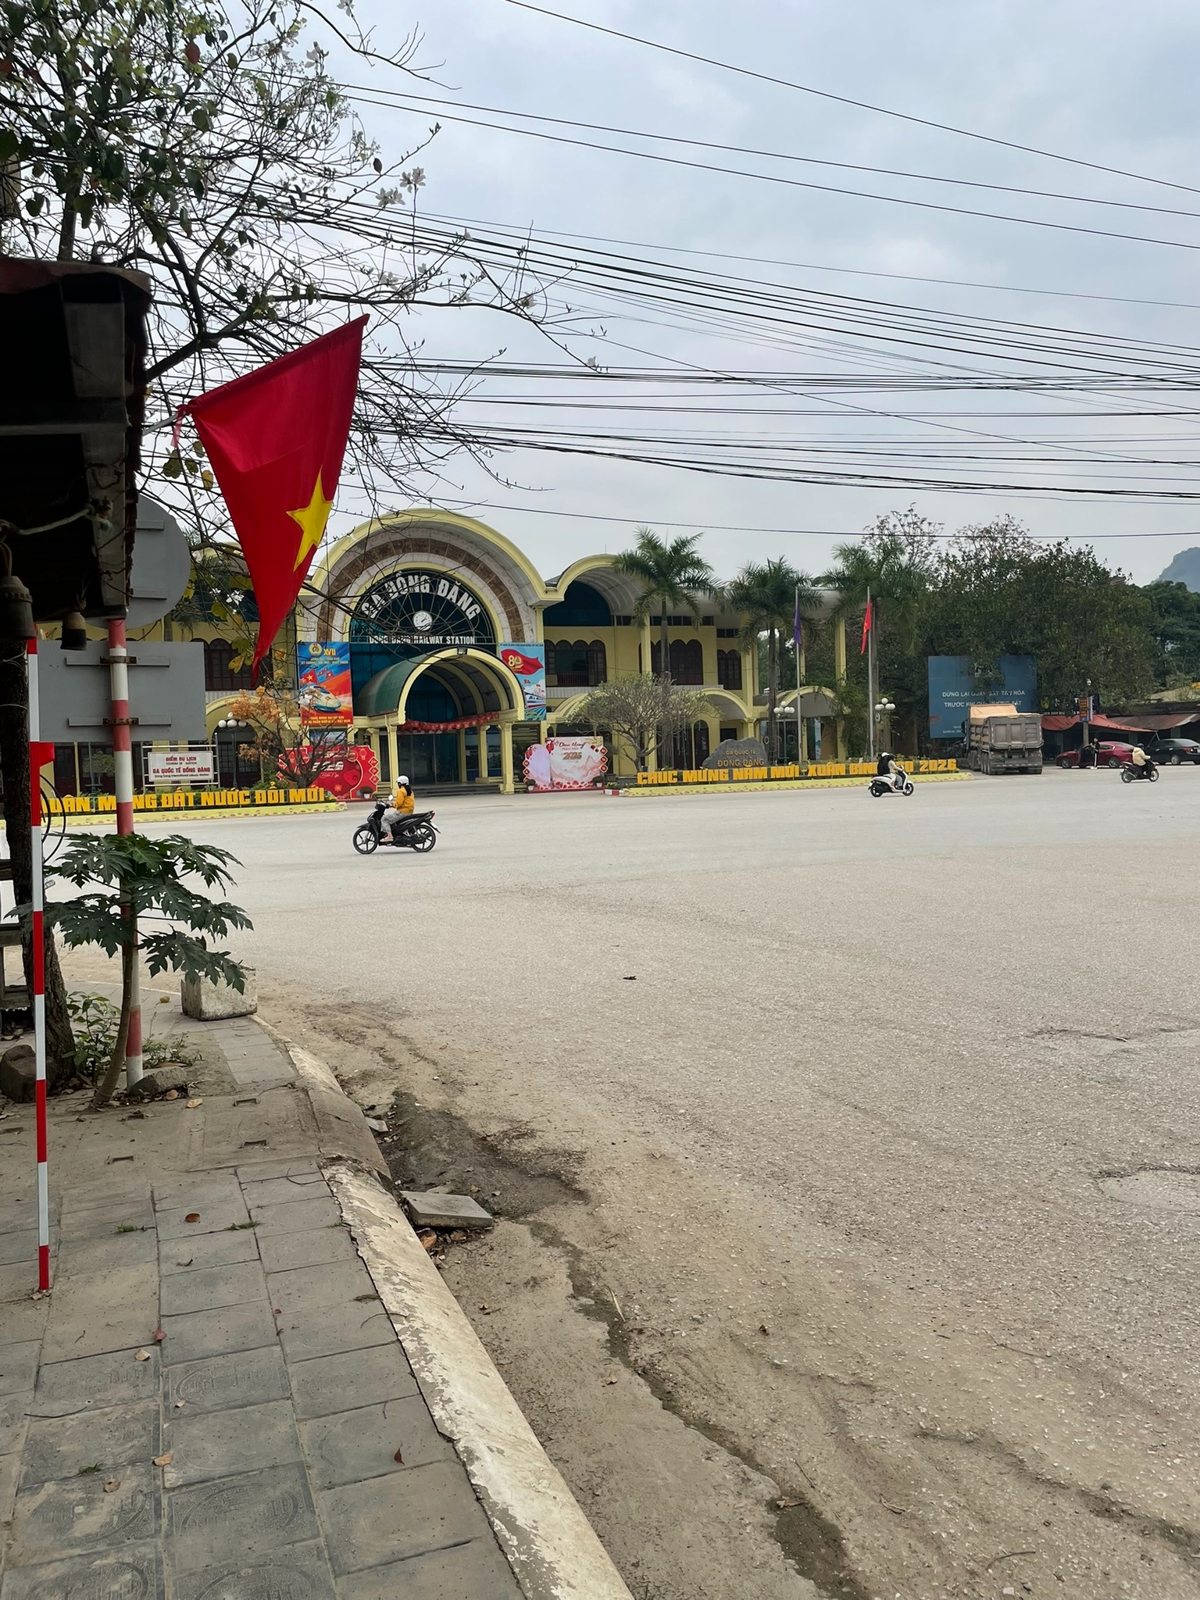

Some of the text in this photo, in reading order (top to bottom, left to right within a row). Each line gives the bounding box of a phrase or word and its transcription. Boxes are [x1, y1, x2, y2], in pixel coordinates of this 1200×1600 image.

[361, 591, 386, 619] GA
[437, 579, 481, 620] ĐĂNG
[413, 635, 443, 645] RAILWAY
[446, 635, 476, 645] STATION
[508, 655, 522, 667] 80
[637, 768, 678, 785] CHÚC
[682, 766, 729, 783] MỪNG
[733, 763, 768, 780] NĂM
[771, 761, 800, 779] MỚI
[808, 761, 846, 777] XUÂN
[919, 758, 957, 772] 2026
[98, 793, 157, 811] MNG
[161, 786, 196, 808] ĐẤT
[200, 787, 251, 806] NƯỚC
[255, 781, 285, 804] ĐỔI
[289, 784, 325, 803] MỚI
